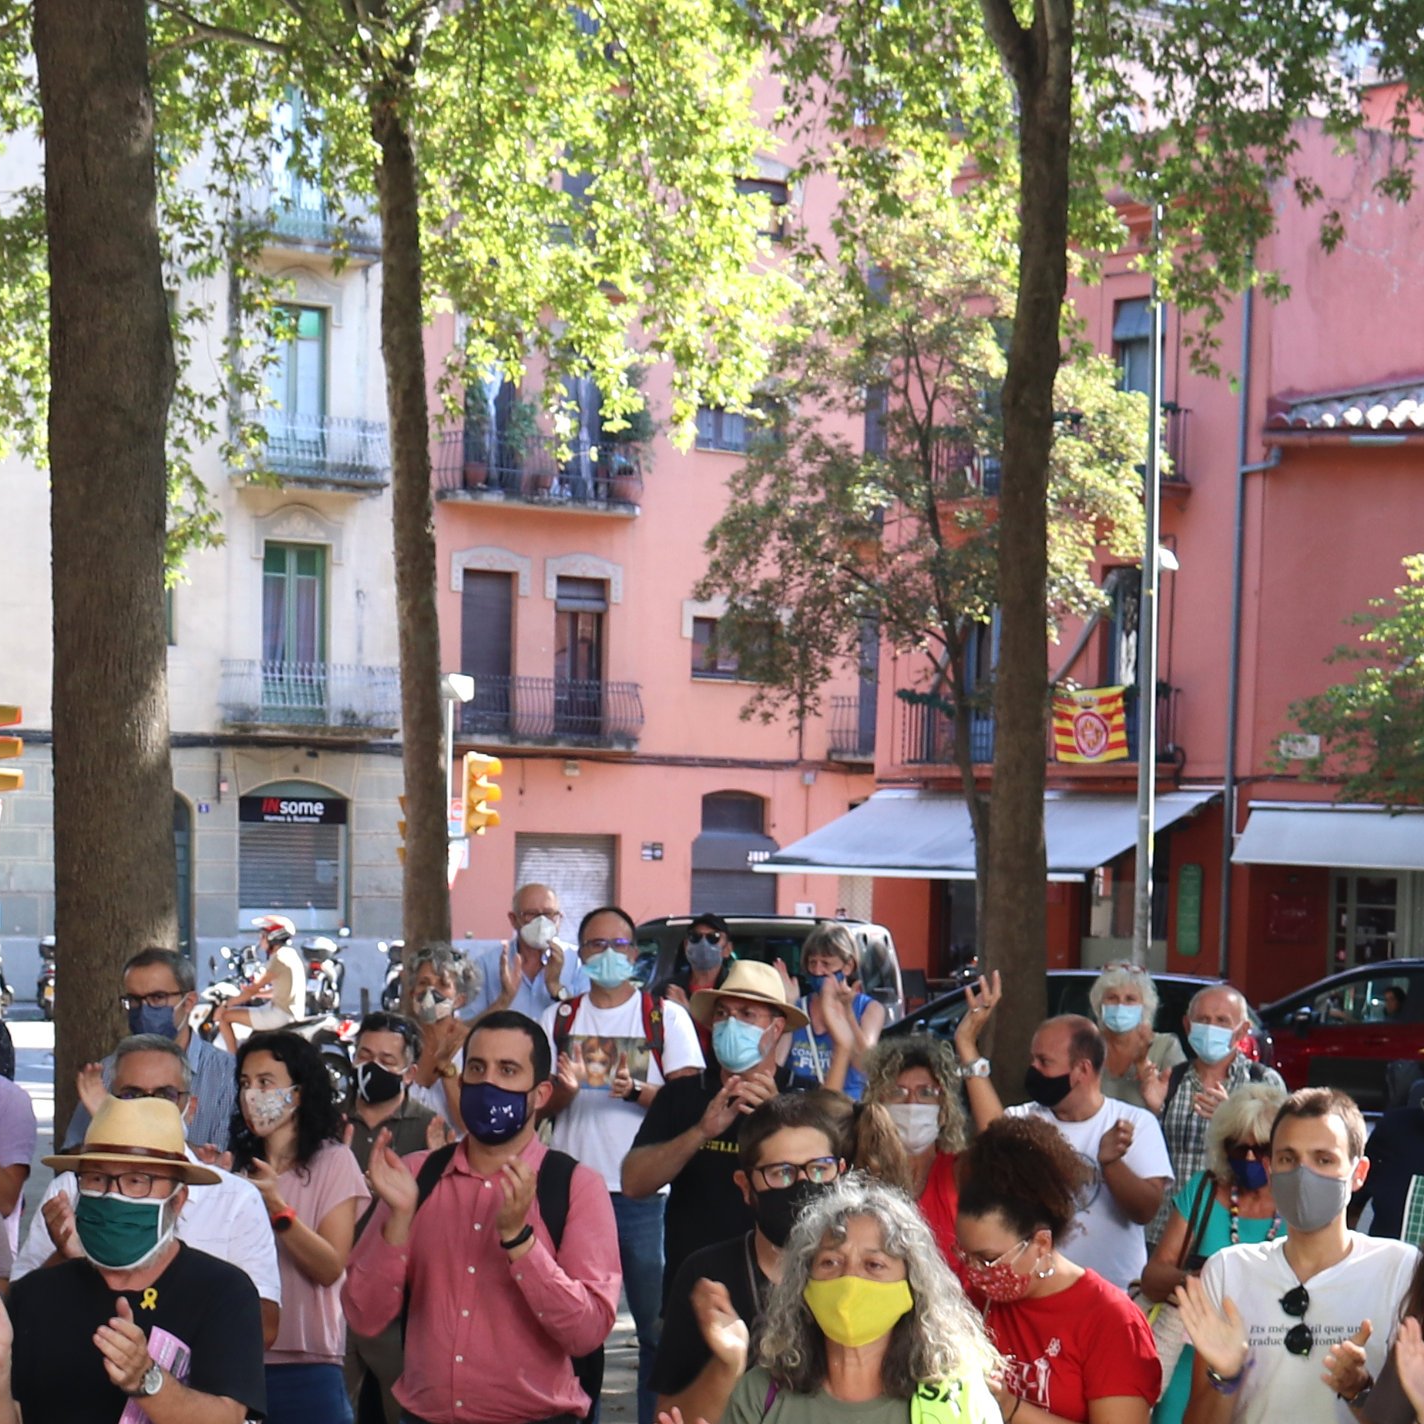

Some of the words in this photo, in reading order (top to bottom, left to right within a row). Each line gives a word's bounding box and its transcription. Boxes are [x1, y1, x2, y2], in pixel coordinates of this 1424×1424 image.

[1250, 1325, 1265, 1334] Ets
[1324, 1326, 1345, 1336] que
[1347, 1326, 1363, 1334] un
